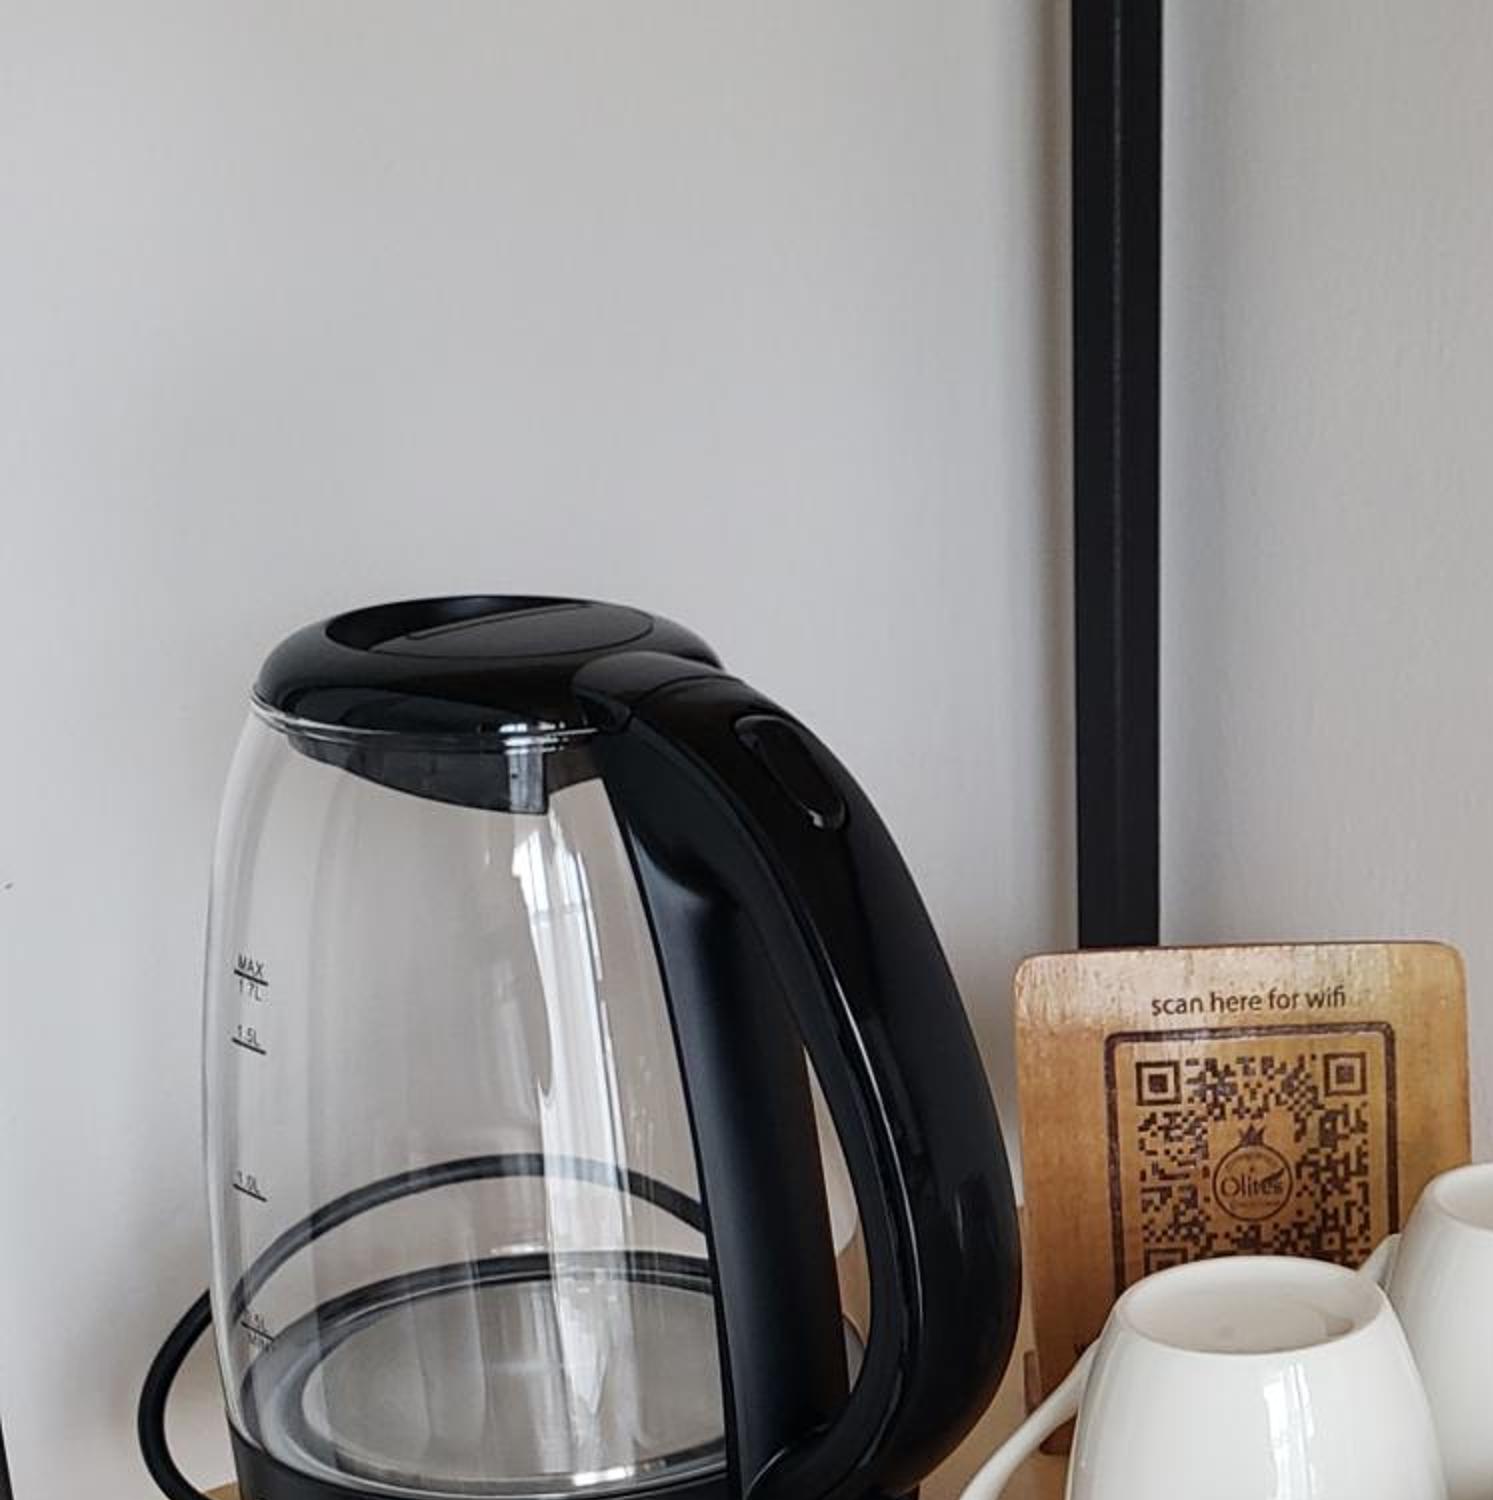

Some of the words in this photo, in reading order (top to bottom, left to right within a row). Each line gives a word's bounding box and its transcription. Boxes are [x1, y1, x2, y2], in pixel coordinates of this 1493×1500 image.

[238, 953, 263, 977] MAX
[1151, 998, 1204, 1017] scan
[1210, 992, 1262, 1013] here
[1268, 987, 1299, 1010] for
[1304, 985, 1346, 1009] wifi
